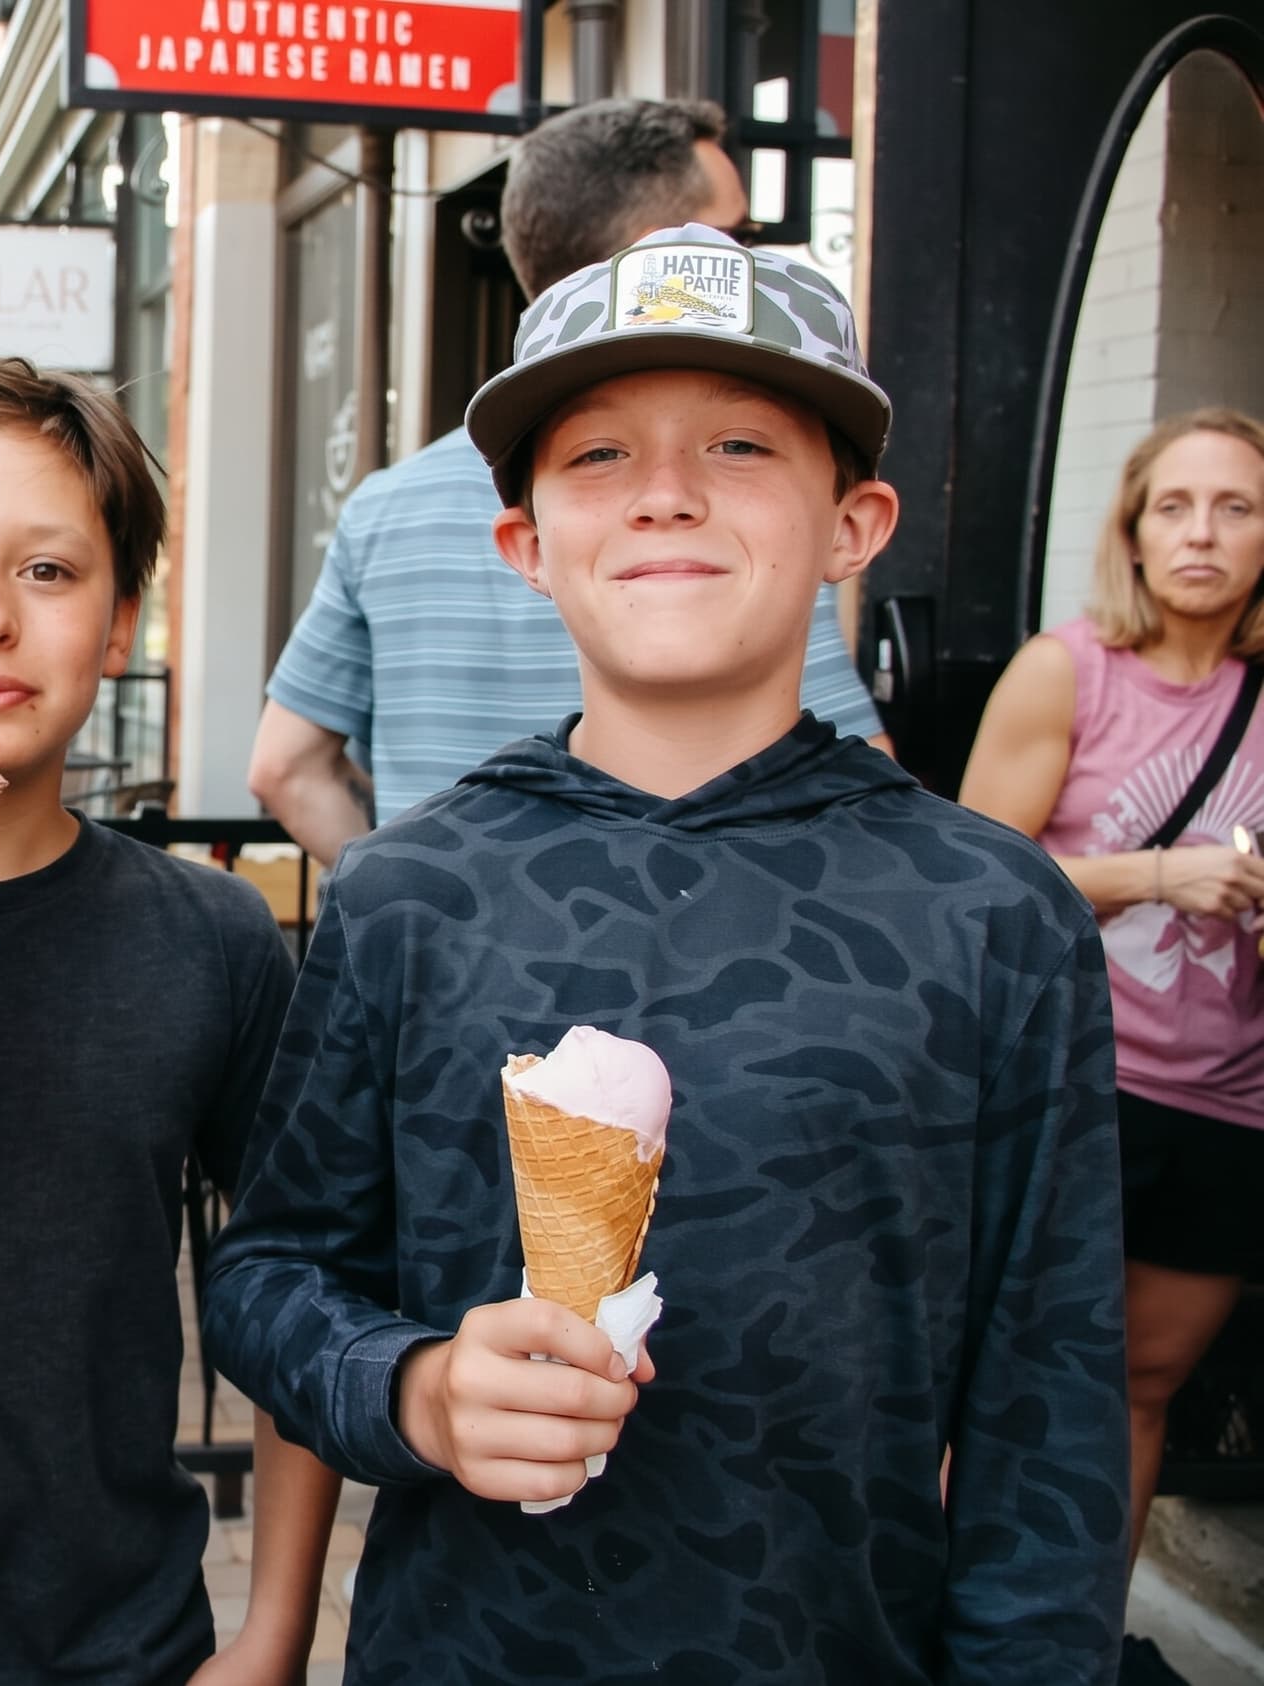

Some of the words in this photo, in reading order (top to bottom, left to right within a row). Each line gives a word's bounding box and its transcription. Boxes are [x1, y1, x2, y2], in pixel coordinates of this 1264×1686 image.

[200, 0, 413, 46] AUTHENTIC
[137, 34, 329, 82] JAPANESE
[349, 48, 471, 91] RAMEN
[663, 255, 743, 280] HATTIE
[683, 275, 740, 296] PATTIE
